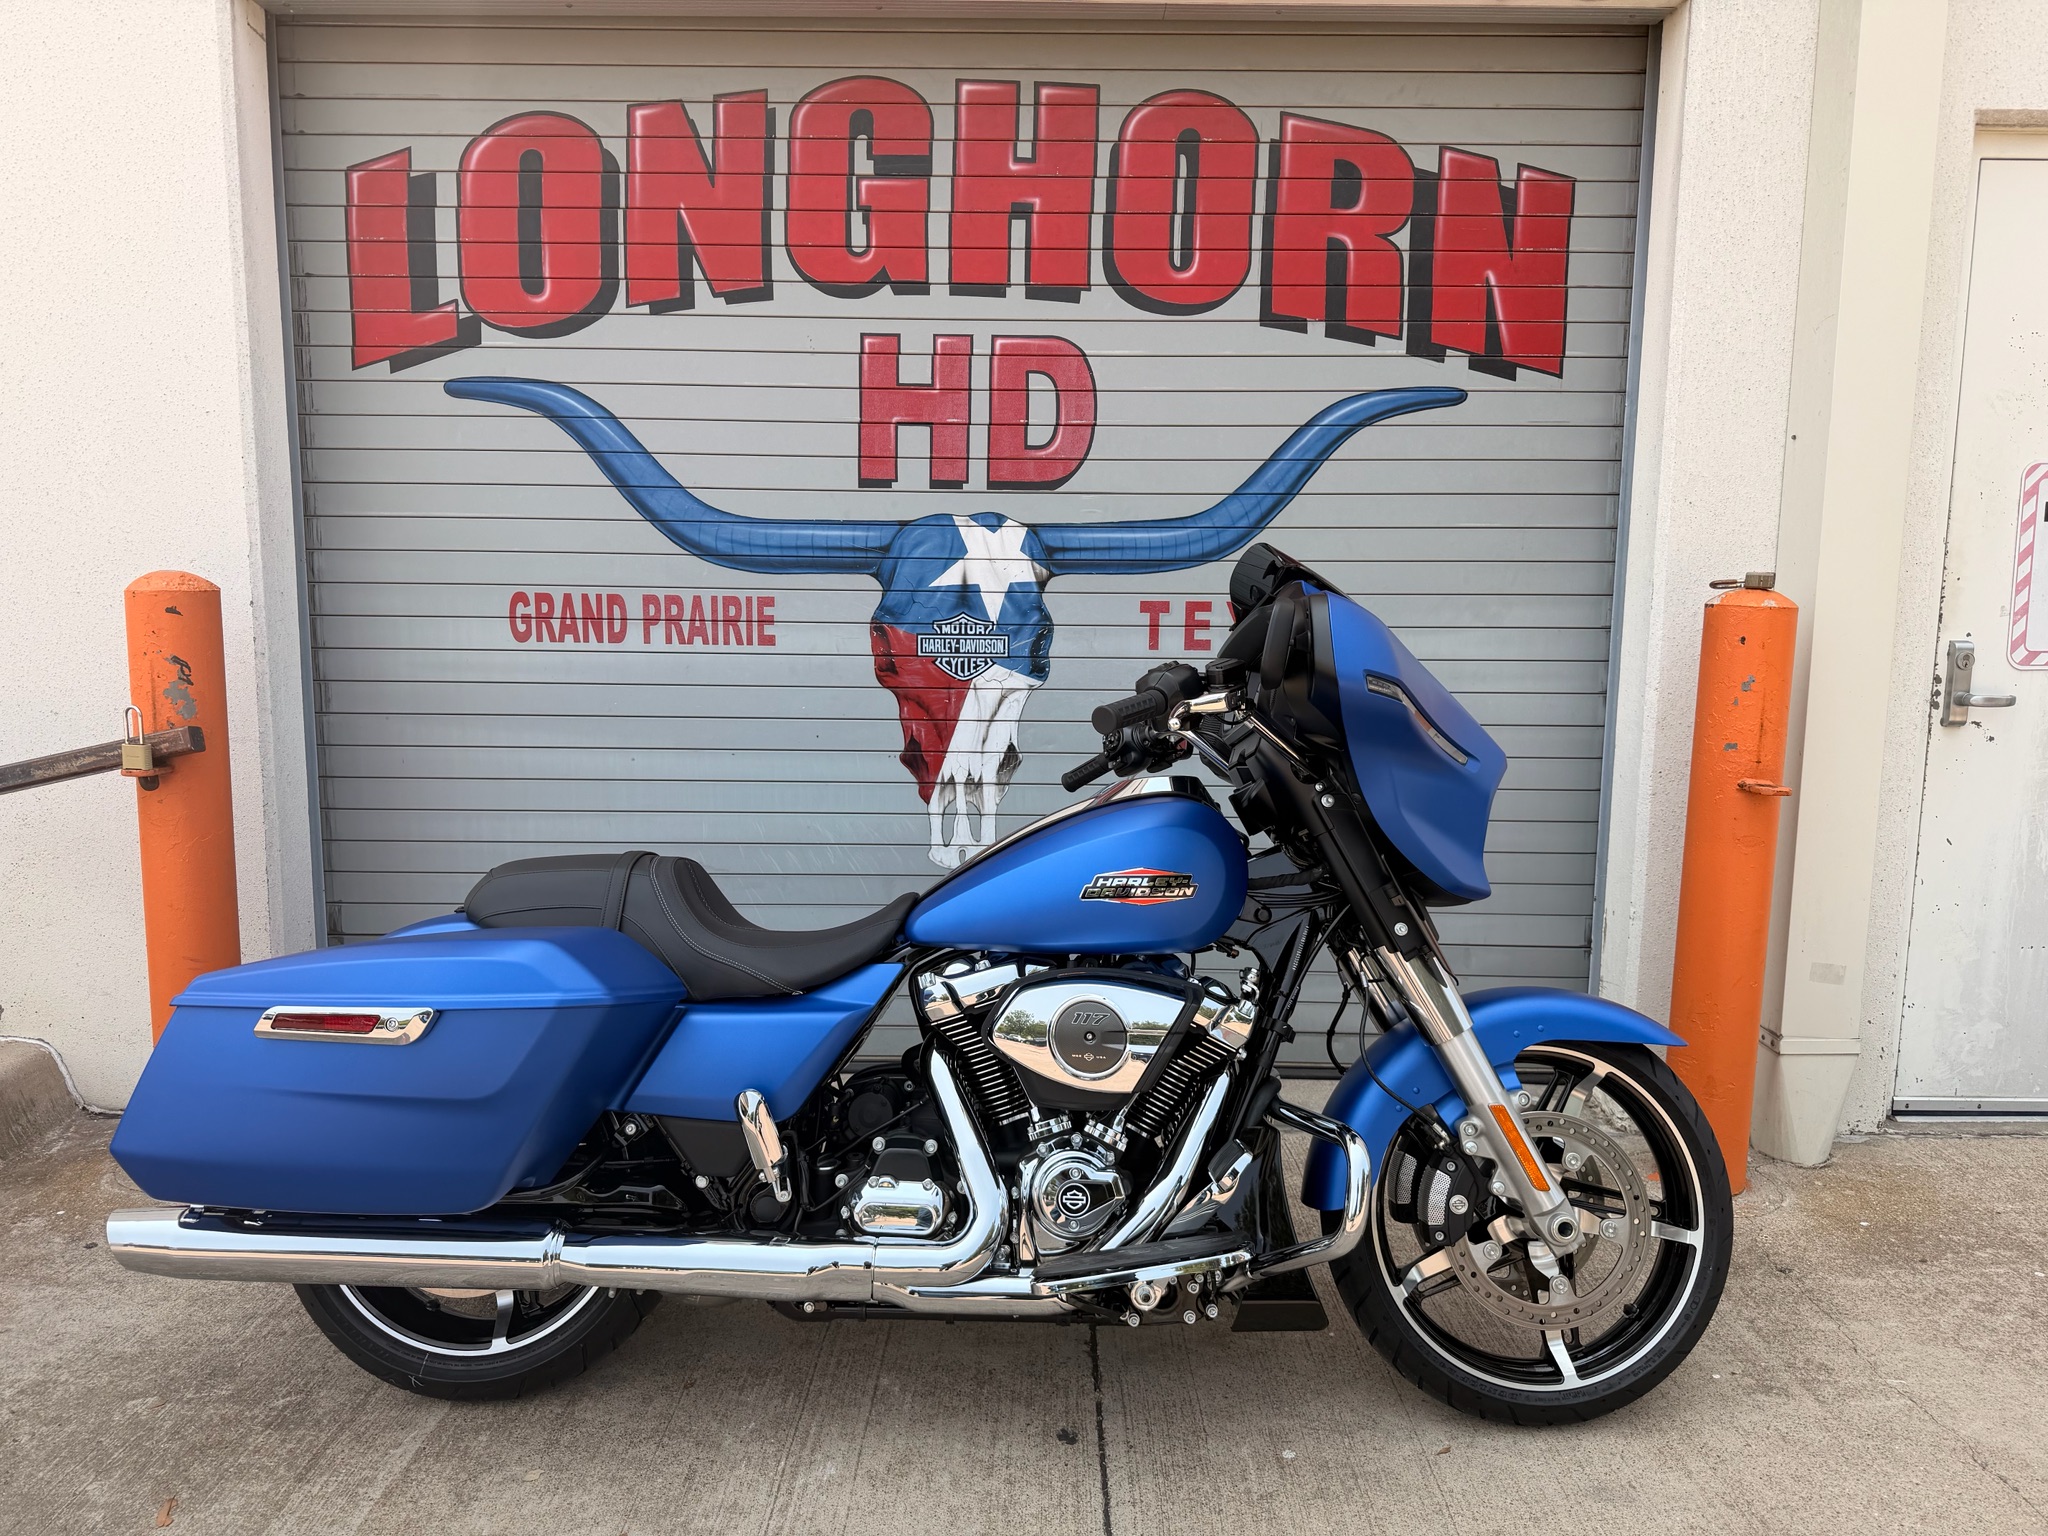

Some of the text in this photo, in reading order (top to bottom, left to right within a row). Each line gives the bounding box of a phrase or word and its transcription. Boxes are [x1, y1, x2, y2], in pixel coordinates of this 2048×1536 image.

[345, 75, 1576, 381] LONGHORN
[858, 332, 1098, 490] HD
[508, 591, 776, 646] GRAND PRAIRIE
[941, 618, 985, 634] MOTOR
[1140, 600, 1236, 651] TE
[922, 638, 1004, 653] HARLEY-DAVIDSON
[941, 657, 985, 677] CYCLES
[1084, 886, 1194, 898] DAVIDSON
[1071, 1011, 1110, 1026] 117
